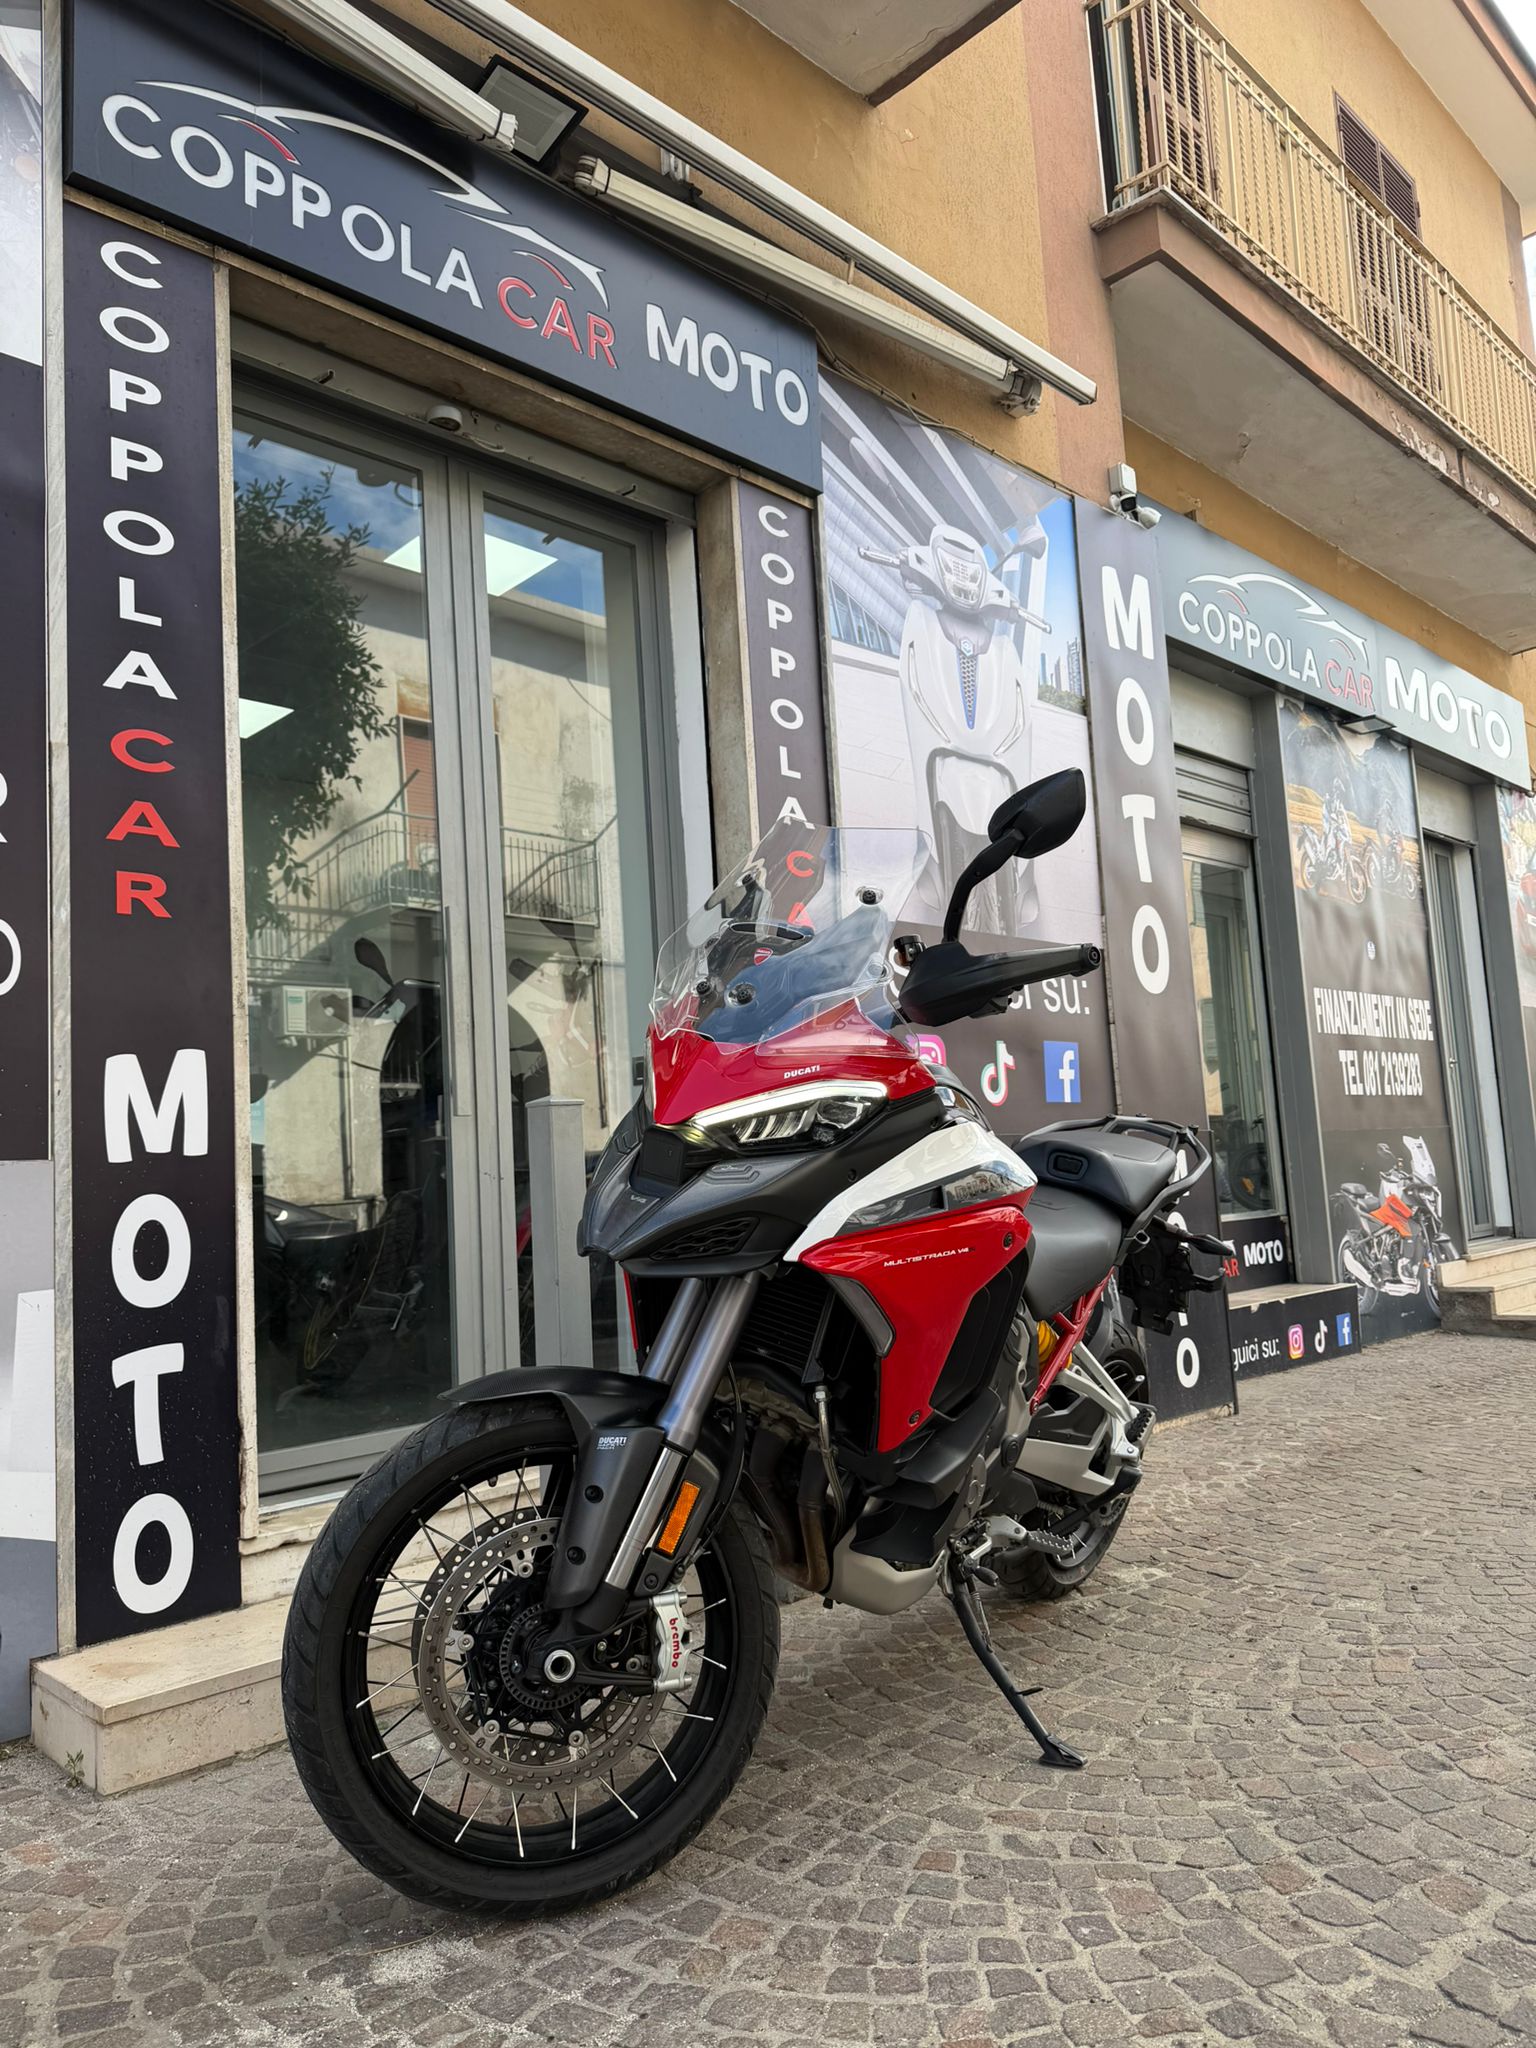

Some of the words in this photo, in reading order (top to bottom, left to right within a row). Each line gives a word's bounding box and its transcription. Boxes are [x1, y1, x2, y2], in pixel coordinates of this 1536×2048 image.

[101, 93, 484, 310] COPPOLA
[497, 276, 618, 369] CAR
[646, 303, 809, 427] MOTO
[100, 241, 178, 700] COPPOLA
[758, 505, 816, 830] COPPOLA
[1179, 591, 1322, 688] COPPOLA
[1324, 659, 1376, 712] CAR
[1385, 656, 1512, 760] MOTO
[1101, 565, 1170, 995] MOTO
[105, 728, 181, 919] CAR
[1313, 987, 1397, 1038] FINANZIAMENTI
[1395, 996, 1410, 1039] IN
[1408, 997, 1434, 1041] SEDE
[783, 1064, 821, 1080] DUCATI
[1338, 1049, 1364, 1096] TEL
[1363, 1050, 1382, 1097] 081
[1381, 1051, 1423, 1097] 2139283
[883, 1249, 956, 1268] MULTISTRADA
[1243, 1239, 1284, 1268] MOTO
[104, 1048, 209, 1615] MOTO
[1261, 1338, 1281, 1358] su:
[598, 1436, 628, 1444] DUCATI
[669, 1617, 683, 1669] brembo
